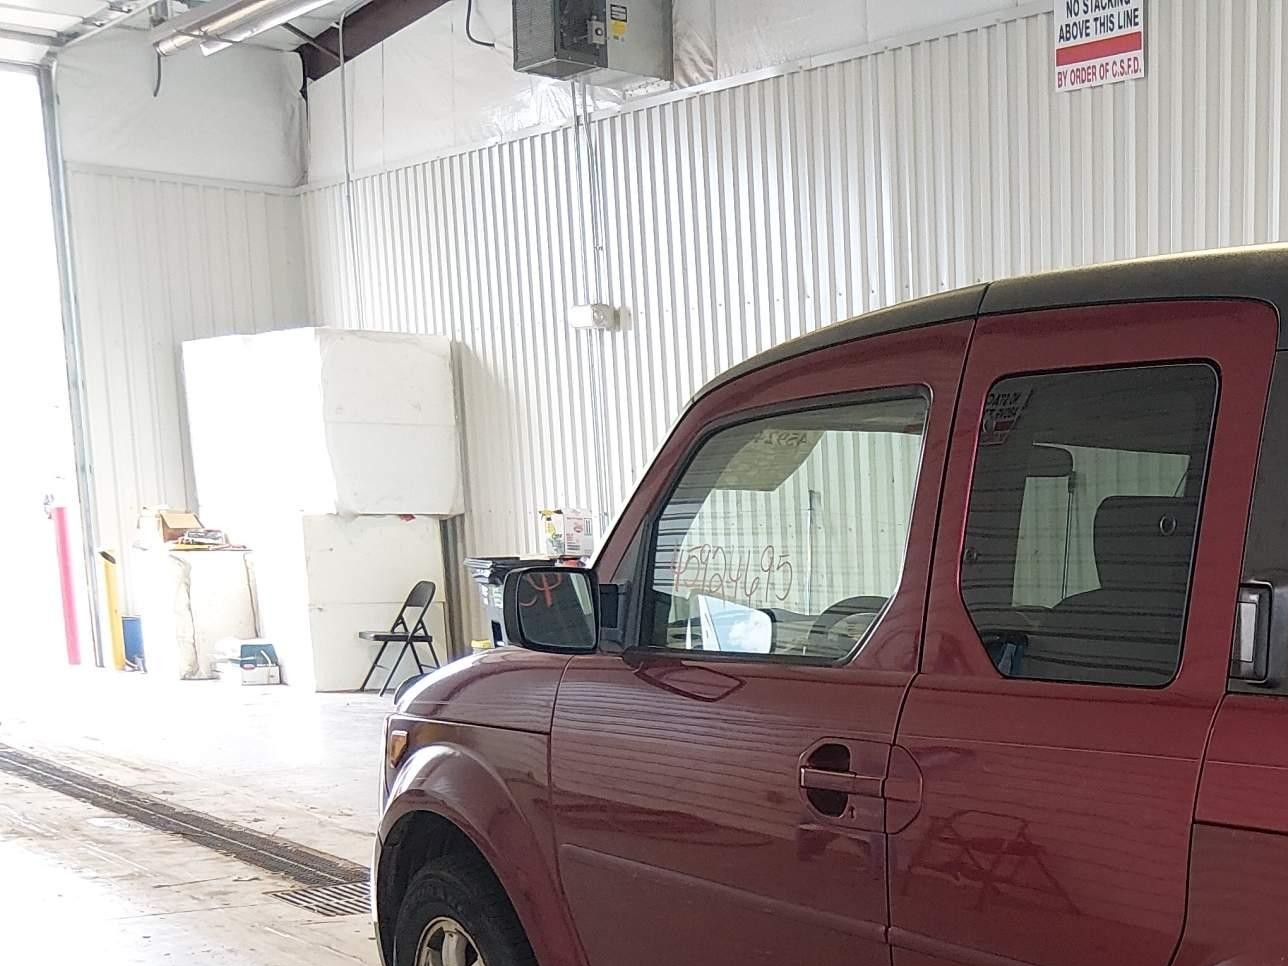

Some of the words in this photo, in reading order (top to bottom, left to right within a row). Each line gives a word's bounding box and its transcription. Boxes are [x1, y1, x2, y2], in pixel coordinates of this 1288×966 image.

[1066, 0, 1080, 18] NO
[1059, 19, 1091, 43] ABOVE
[1093, 14, 1115, 36] THIS
[1118, 8, 1140, 29] LINE
[1057, 70, 1068, 88] BY
[1070, 65, 1097, 86] ORDER
[1099, 62, 1109, 80] OF
[1112, 57, 1142, 78] C.S.F.D.
